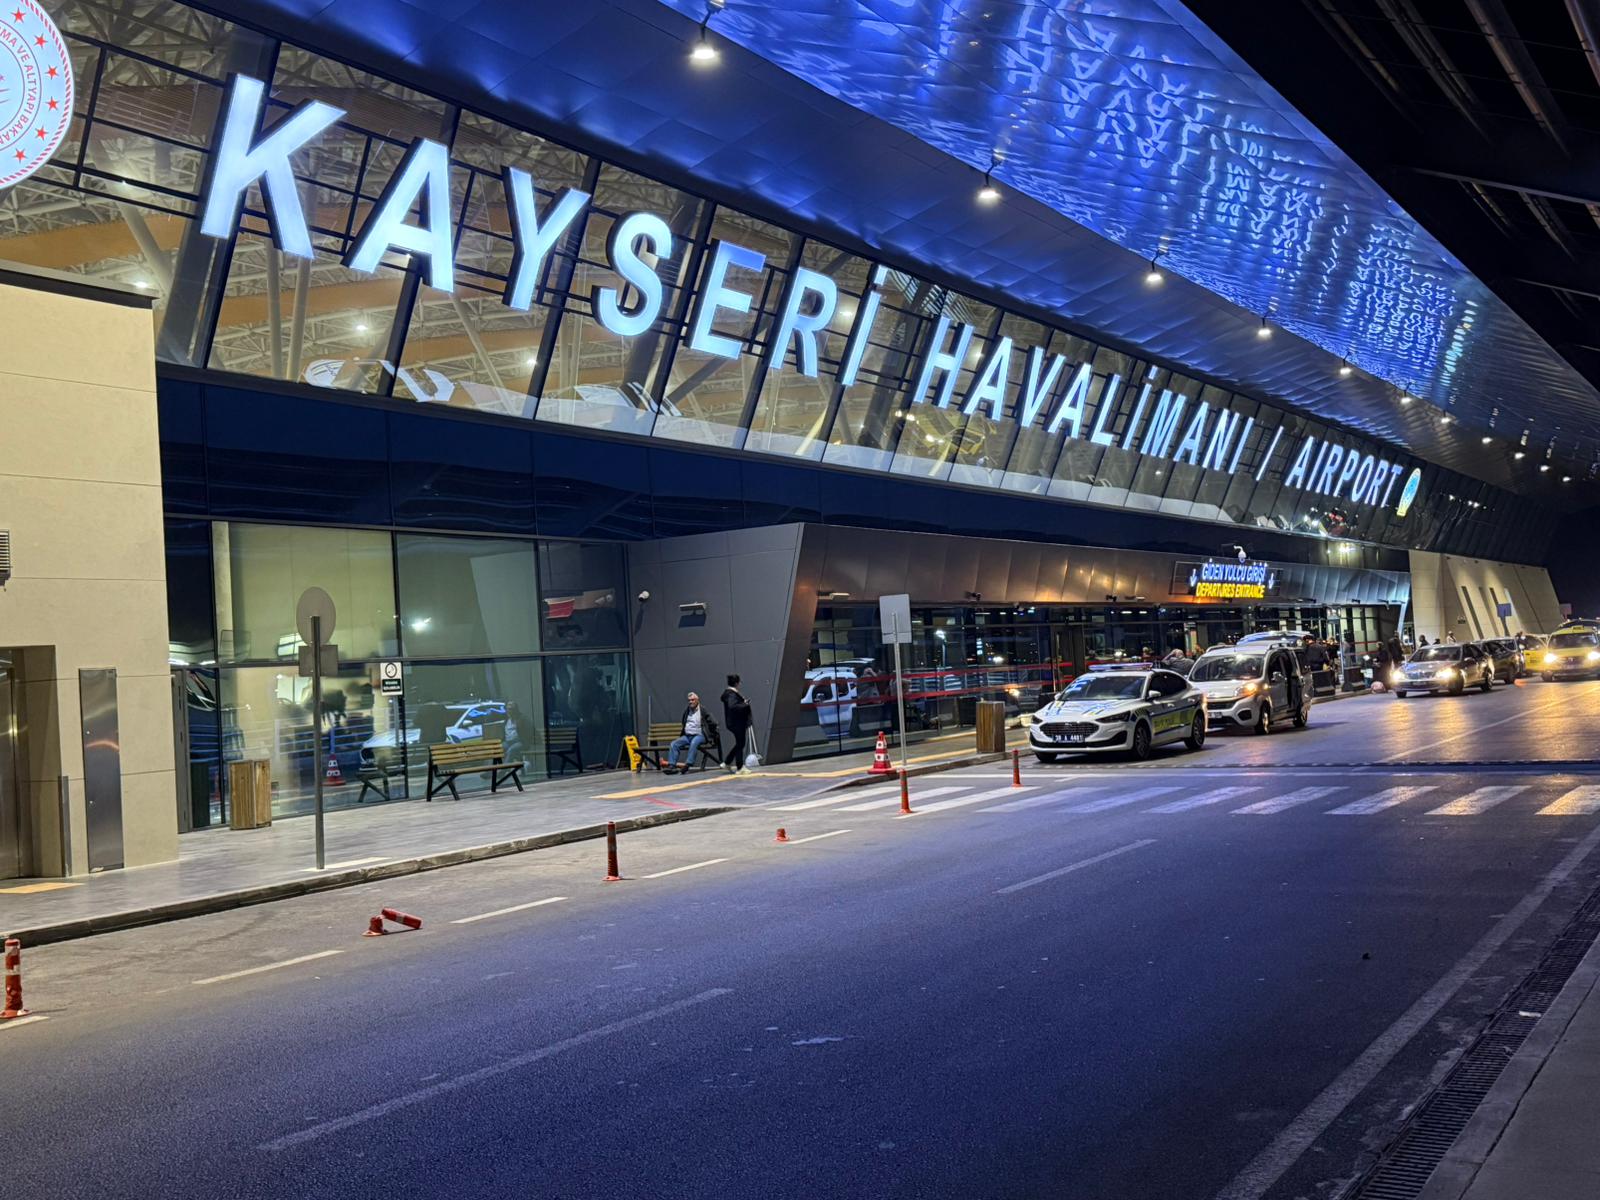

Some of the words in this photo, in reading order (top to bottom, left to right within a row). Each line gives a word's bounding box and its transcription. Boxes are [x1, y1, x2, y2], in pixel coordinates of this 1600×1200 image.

[17, 44, 31, 63] VE
[24, 64, 37, 114] ALTYAPI
[200, 72, 888, 387] KAYSERİ
[913, 315, 1254, 475] HAVALİMANI
[1256, 425, 1284, 481] /
[1284, 435, 1404, 508] AIRPORT
[1196, 582, 1236, 598] DEPARTURES
[1235, 584, 1265, 598] ENTRANCE
[1224, 564, 1247, 582] YOLCU
